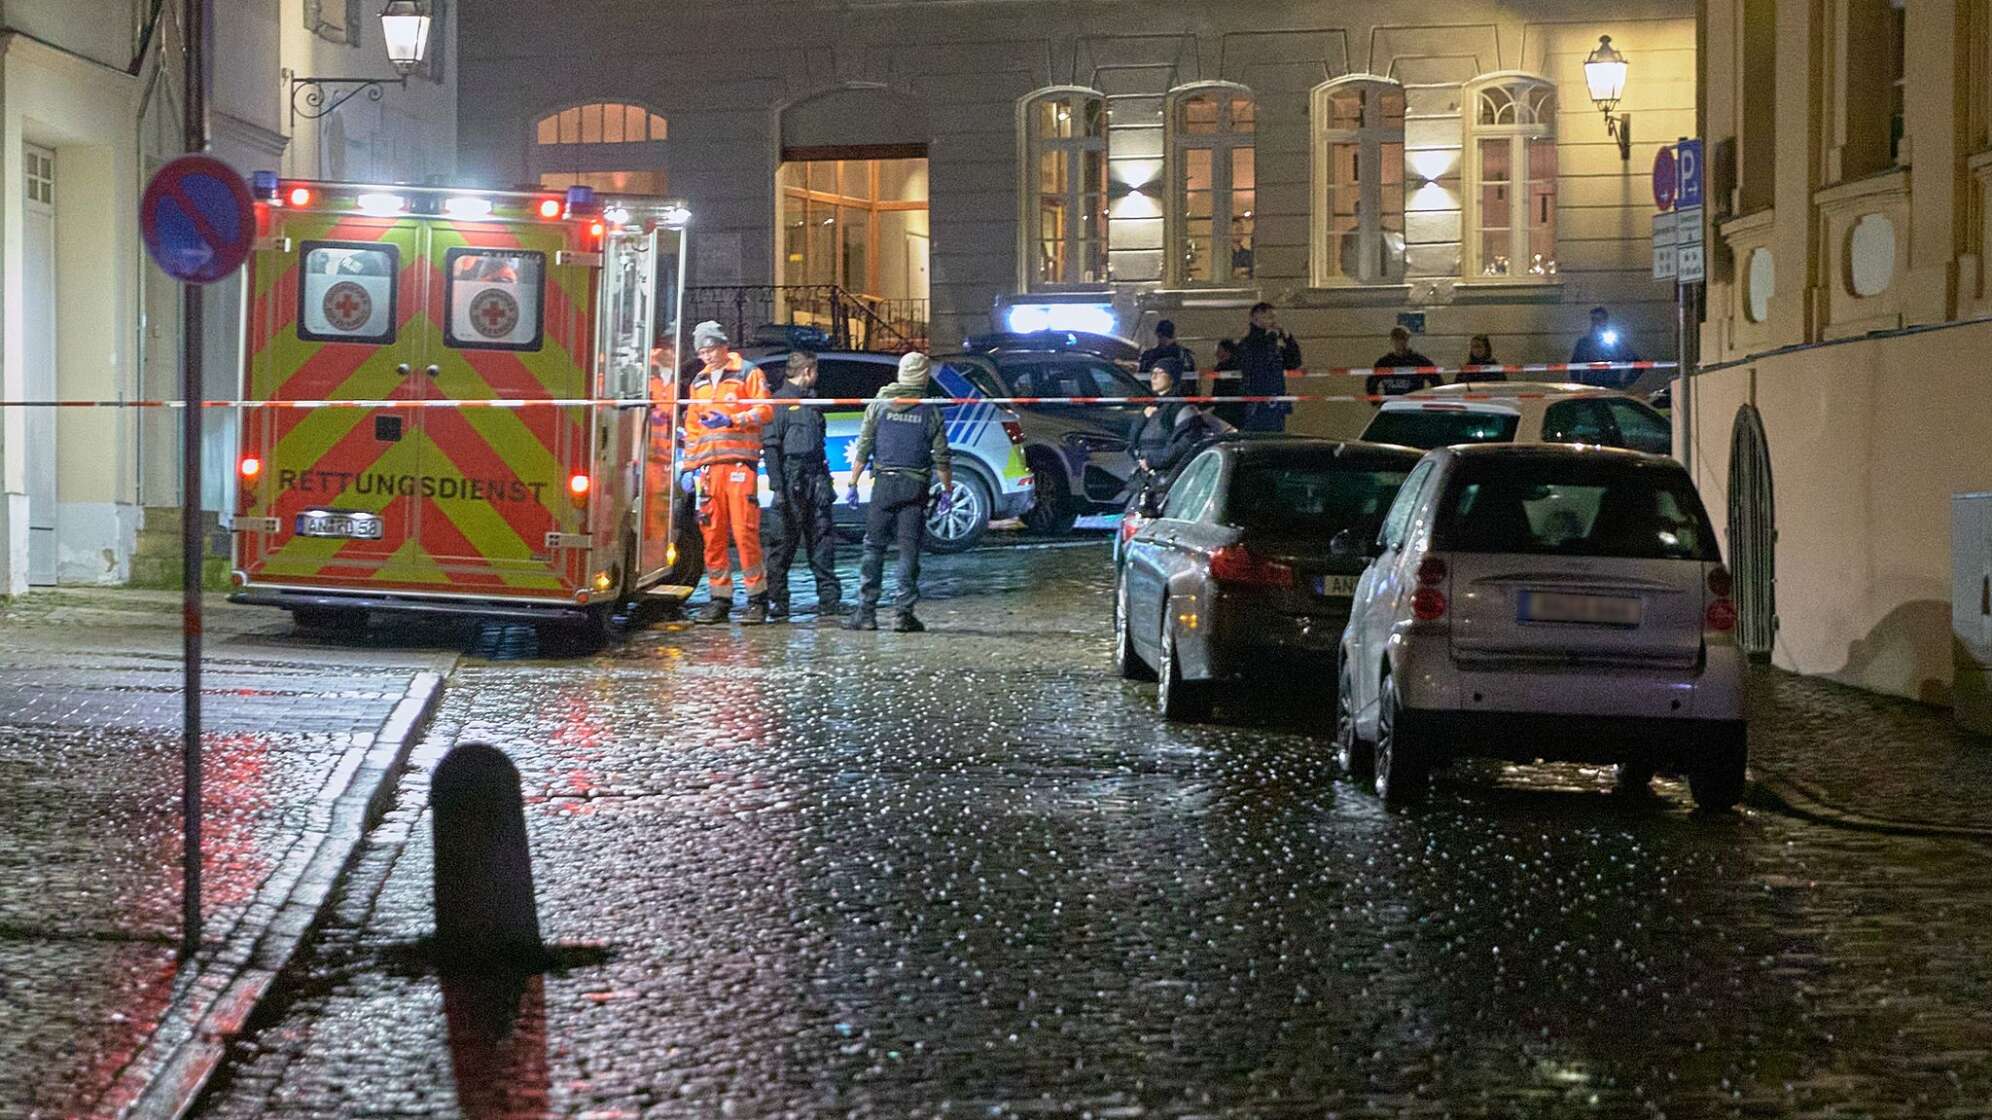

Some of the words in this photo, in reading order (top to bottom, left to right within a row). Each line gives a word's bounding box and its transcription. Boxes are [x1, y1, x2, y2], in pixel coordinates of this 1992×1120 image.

[1681, 149, 1695, 199] P
[886, 412, 922, 423] POLIZEI
[278, 469, 548, 503] RETTUNGSDIENST
